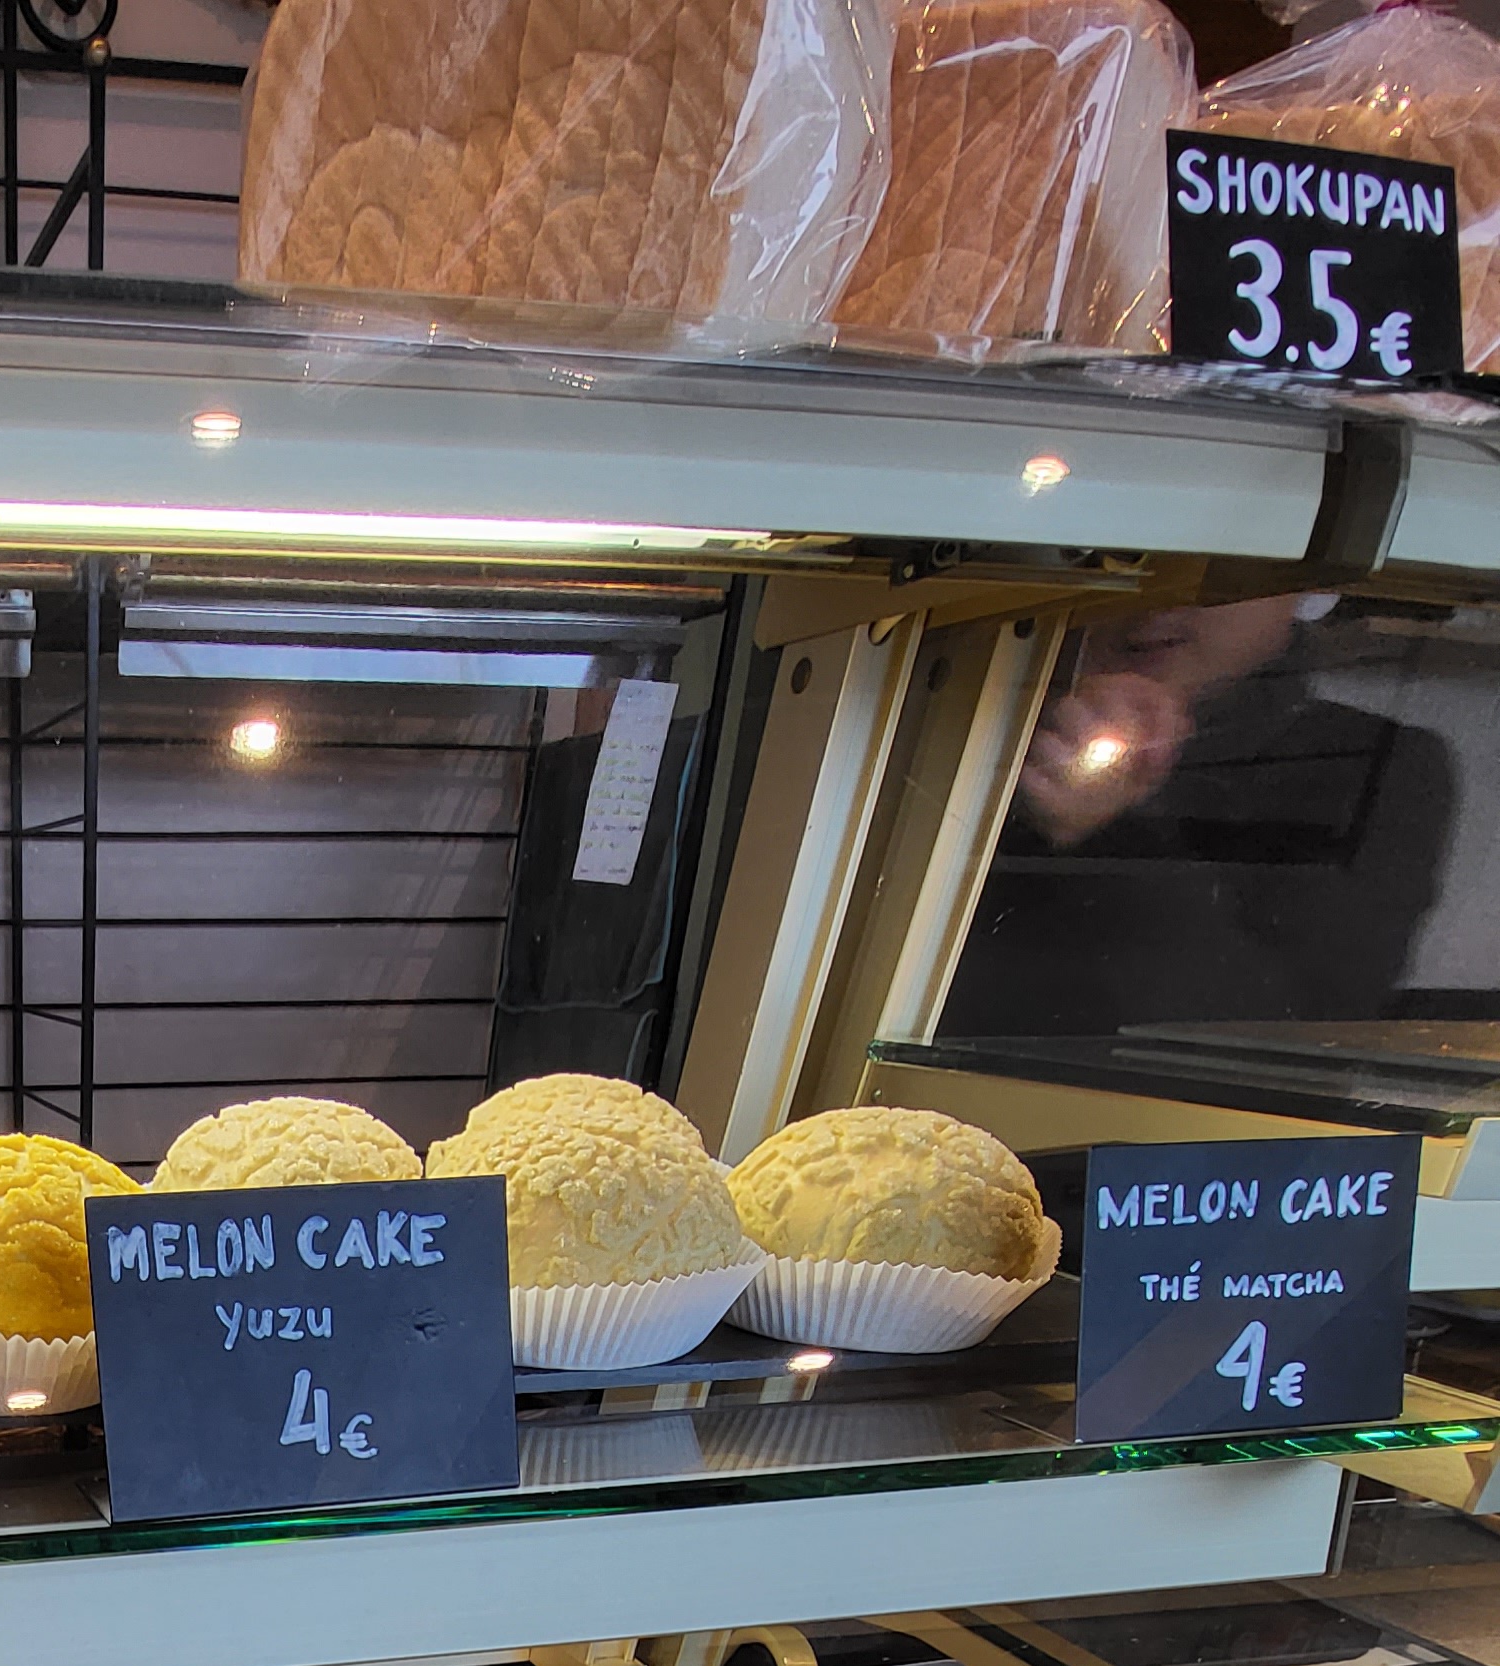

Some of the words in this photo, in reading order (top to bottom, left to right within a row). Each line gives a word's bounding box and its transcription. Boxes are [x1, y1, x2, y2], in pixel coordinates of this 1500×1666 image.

[1177, 148, 1445, 236] SHOKUPAN
[1097, 1179, 1260, 1230] MELON
[1280, 1170, 1395, 1225] CAKE
[106, 1214, 276, 1283] MELON
[296, 1210, 447, 1270] CAKE
[1139, 1260, 1202, 1301] THÉ
[1222, 1269, 1345, 1298] MATCHA
